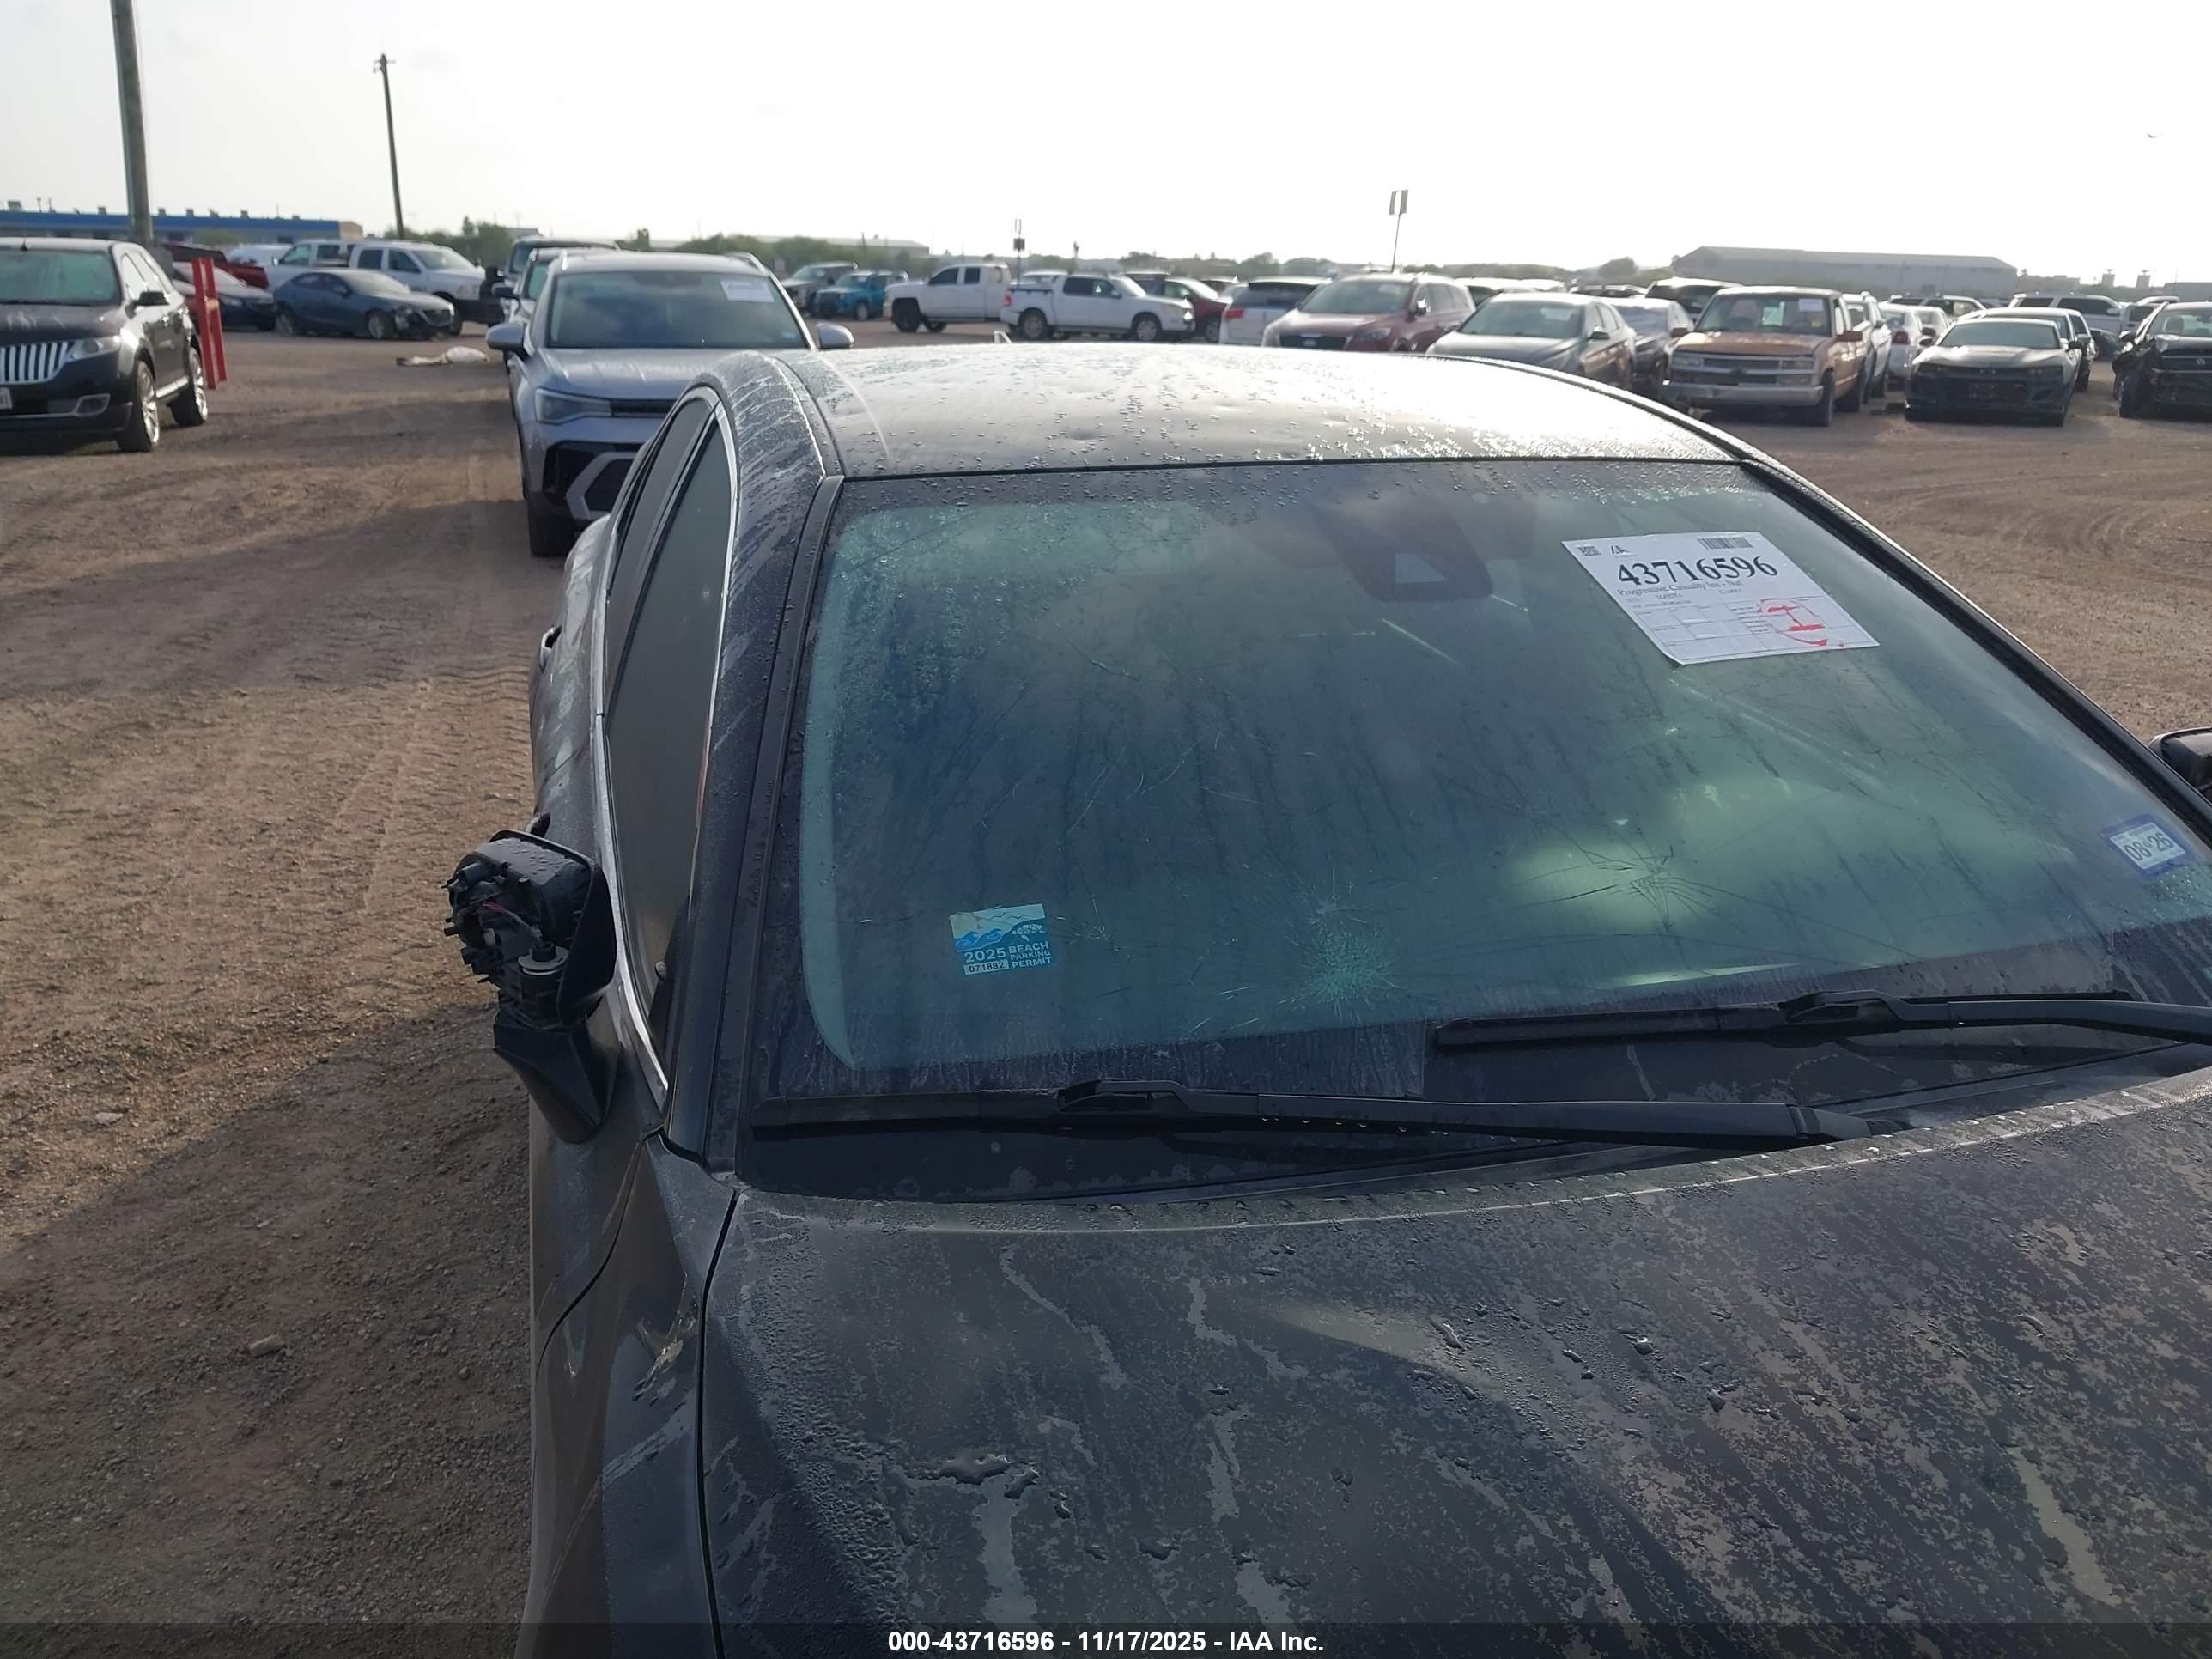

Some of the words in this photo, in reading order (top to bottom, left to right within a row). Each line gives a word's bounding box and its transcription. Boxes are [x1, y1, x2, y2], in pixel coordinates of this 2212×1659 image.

[1619, 556, 1778, 586] 43716596
[2124, 841, 2152, 860] 08
[2147, 831, 2174, 852] 26
[1008, 940, 1049, 954] BEACH
[963, 947, 1006, 963] 2025
[1010, 950, 1051, 961] PARKING
[1012, 957, 1052, 969] PERMIT
